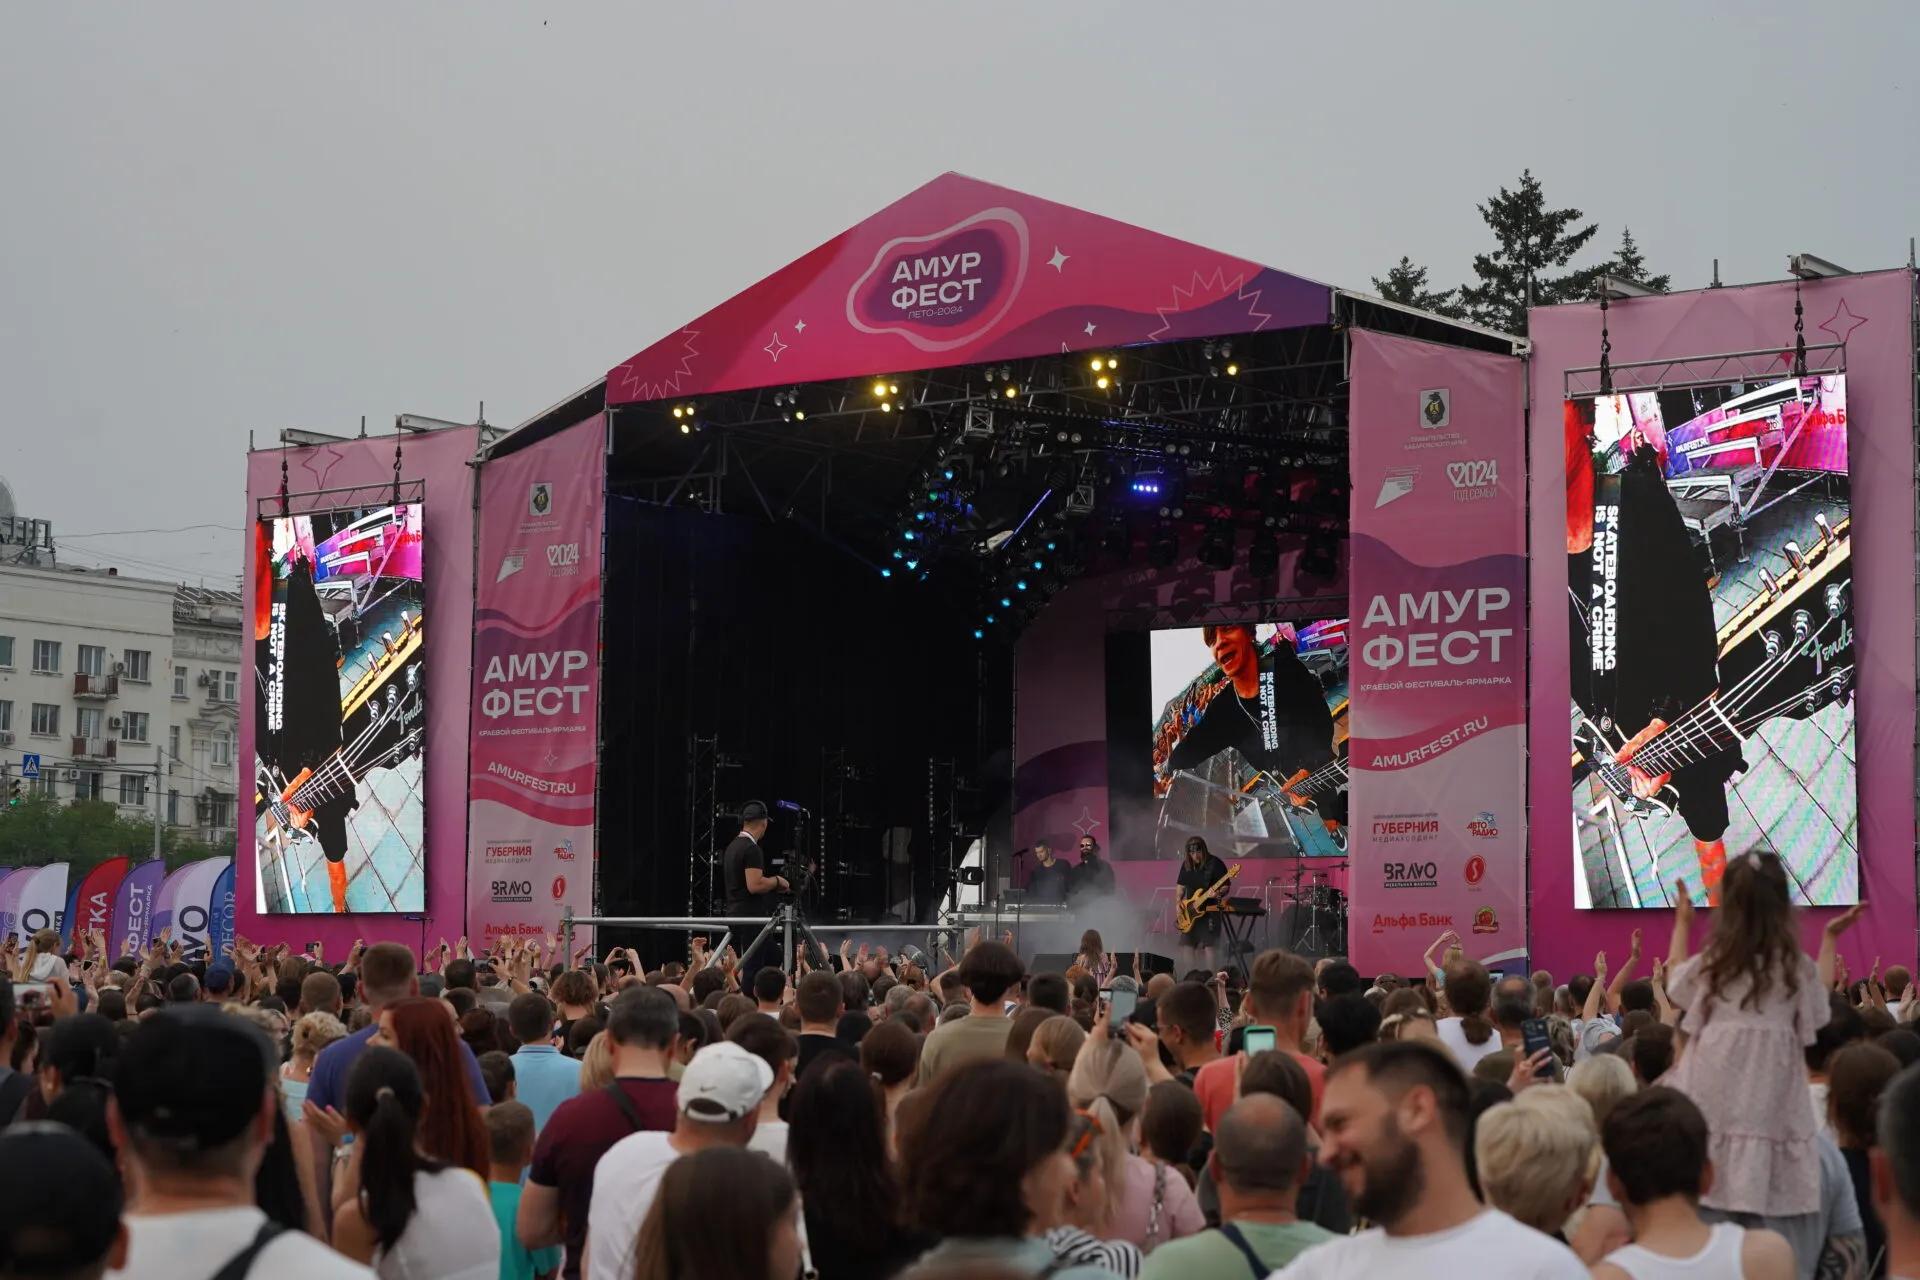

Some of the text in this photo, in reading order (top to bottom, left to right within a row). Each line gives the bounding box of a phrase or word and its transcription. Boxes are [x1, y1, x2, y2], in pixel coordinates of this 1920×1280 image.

[891, 252, 982, 284] АМУР
[891, 278, 982, 310] ФЕСТ
[1453, 460, 1498, 488] 2024
[549, 543, 579, 566] 2024
[1591, 505, 1607, 672] IS NOT A CRIME
[1604, 505, 1619, 670] SKATEBOARDING
[271, 602, 280, 616] IS
[1361, 587, 1511, 629] АМУР
[269, 623, 278, 657] NOT
[1362, 628, 1513, 671] ФЕСТ
[268, 663, 276, 675] A
[275, 602, 287, 730] SKATEBOARDING
[482, 650, 589, 684] АМУР
[1259, 687, 1267, 706] NOT
[1360, 676, 1512, 692] КРАЕВОЙ ФЕСТИВАЛЬ-ЯРМАРКА
[481, 685, 590, 719] ФЕСТ
[1260, 710, 1268, 718] A
[1266, 671, 1279, 750] SKATEBOARDING
[1372, 716, 1488, 768] AMURFEST.RU
[487, 761, 576, 794] AMURFEST.RU
[1373, 821, 1439, 834] ГУБЕРНИЯ
[485, 846, 532, 857] ГУБЕРНИЯ
[1384, 862, 1437, 880] BRAVO
[491, 880, 532, 896] BRAVO
[485, 923, 544, 935] Альфа Банк
[1373, 913, 1453, 930] Альфа Банк
